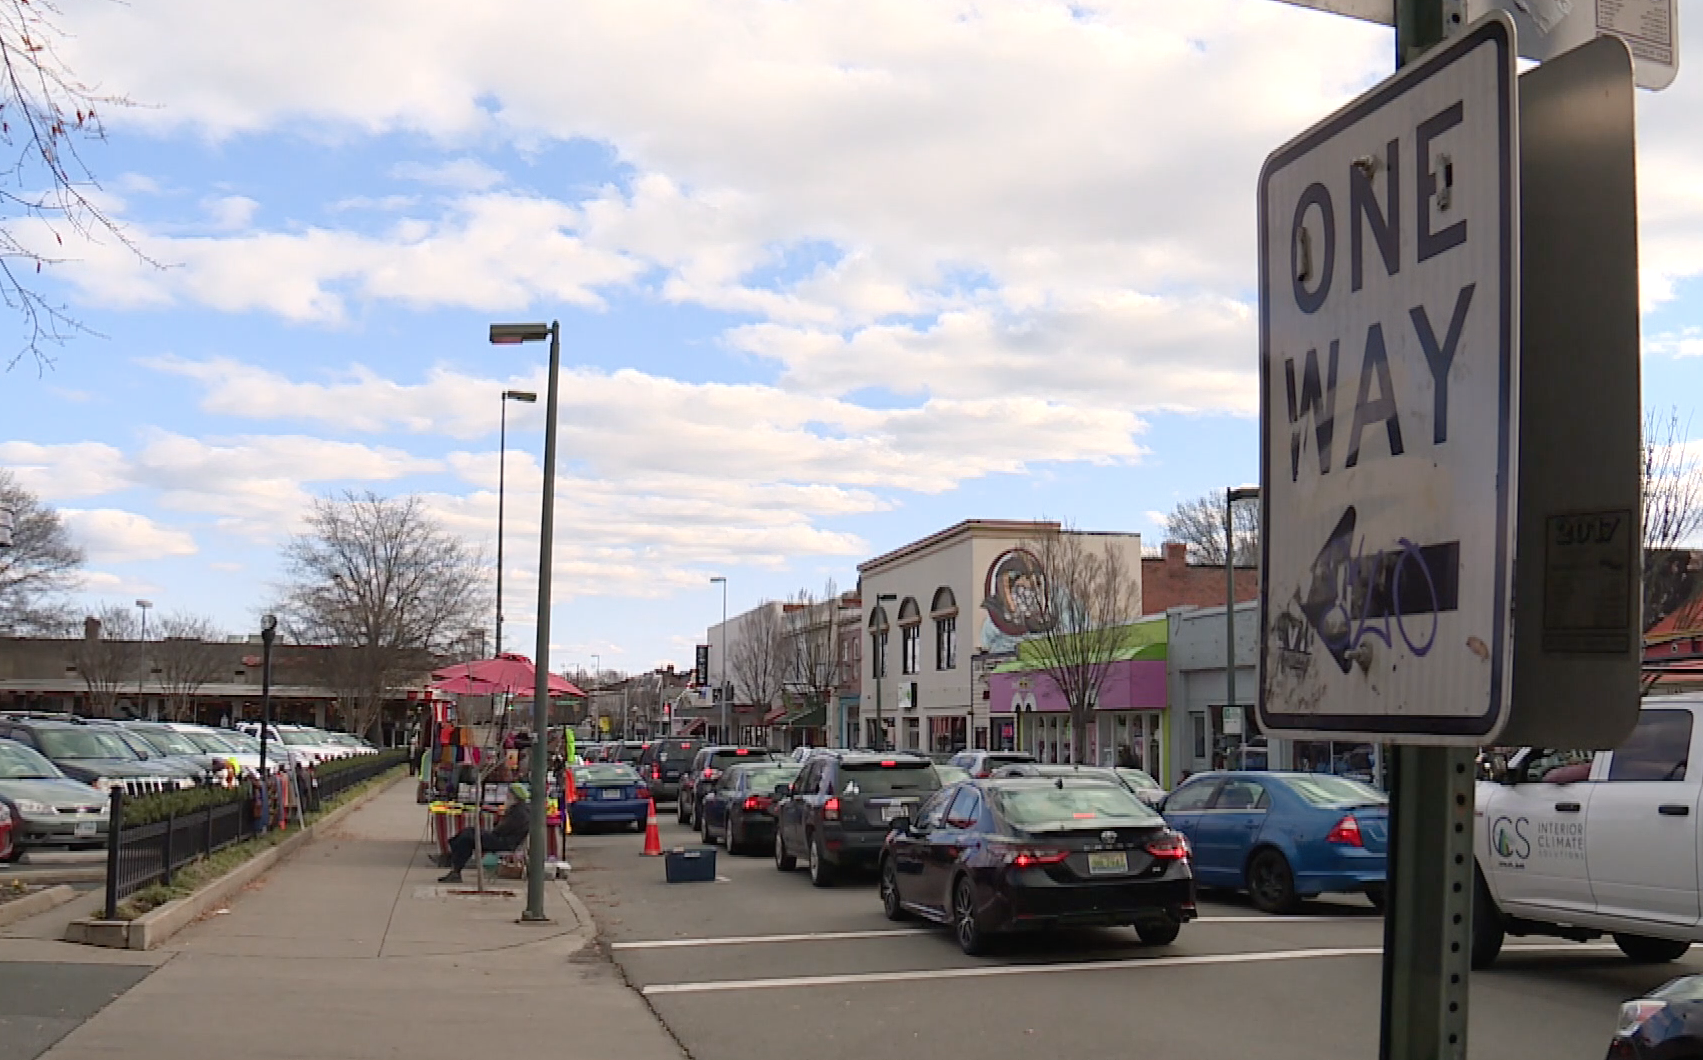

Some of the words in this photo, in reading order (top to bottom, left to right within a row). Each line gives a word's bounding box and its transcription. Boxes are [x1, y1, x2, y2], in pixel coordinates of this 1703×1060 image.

[1291, 100, 1467, 314] ONE
[1285, 282, 1476, 483] WAY
[1487, 815, 1531, 859] ICS
[1537, 834, 1583, 850] CLIMATE
[1538, 822, 1583, 836] INTERIOR
